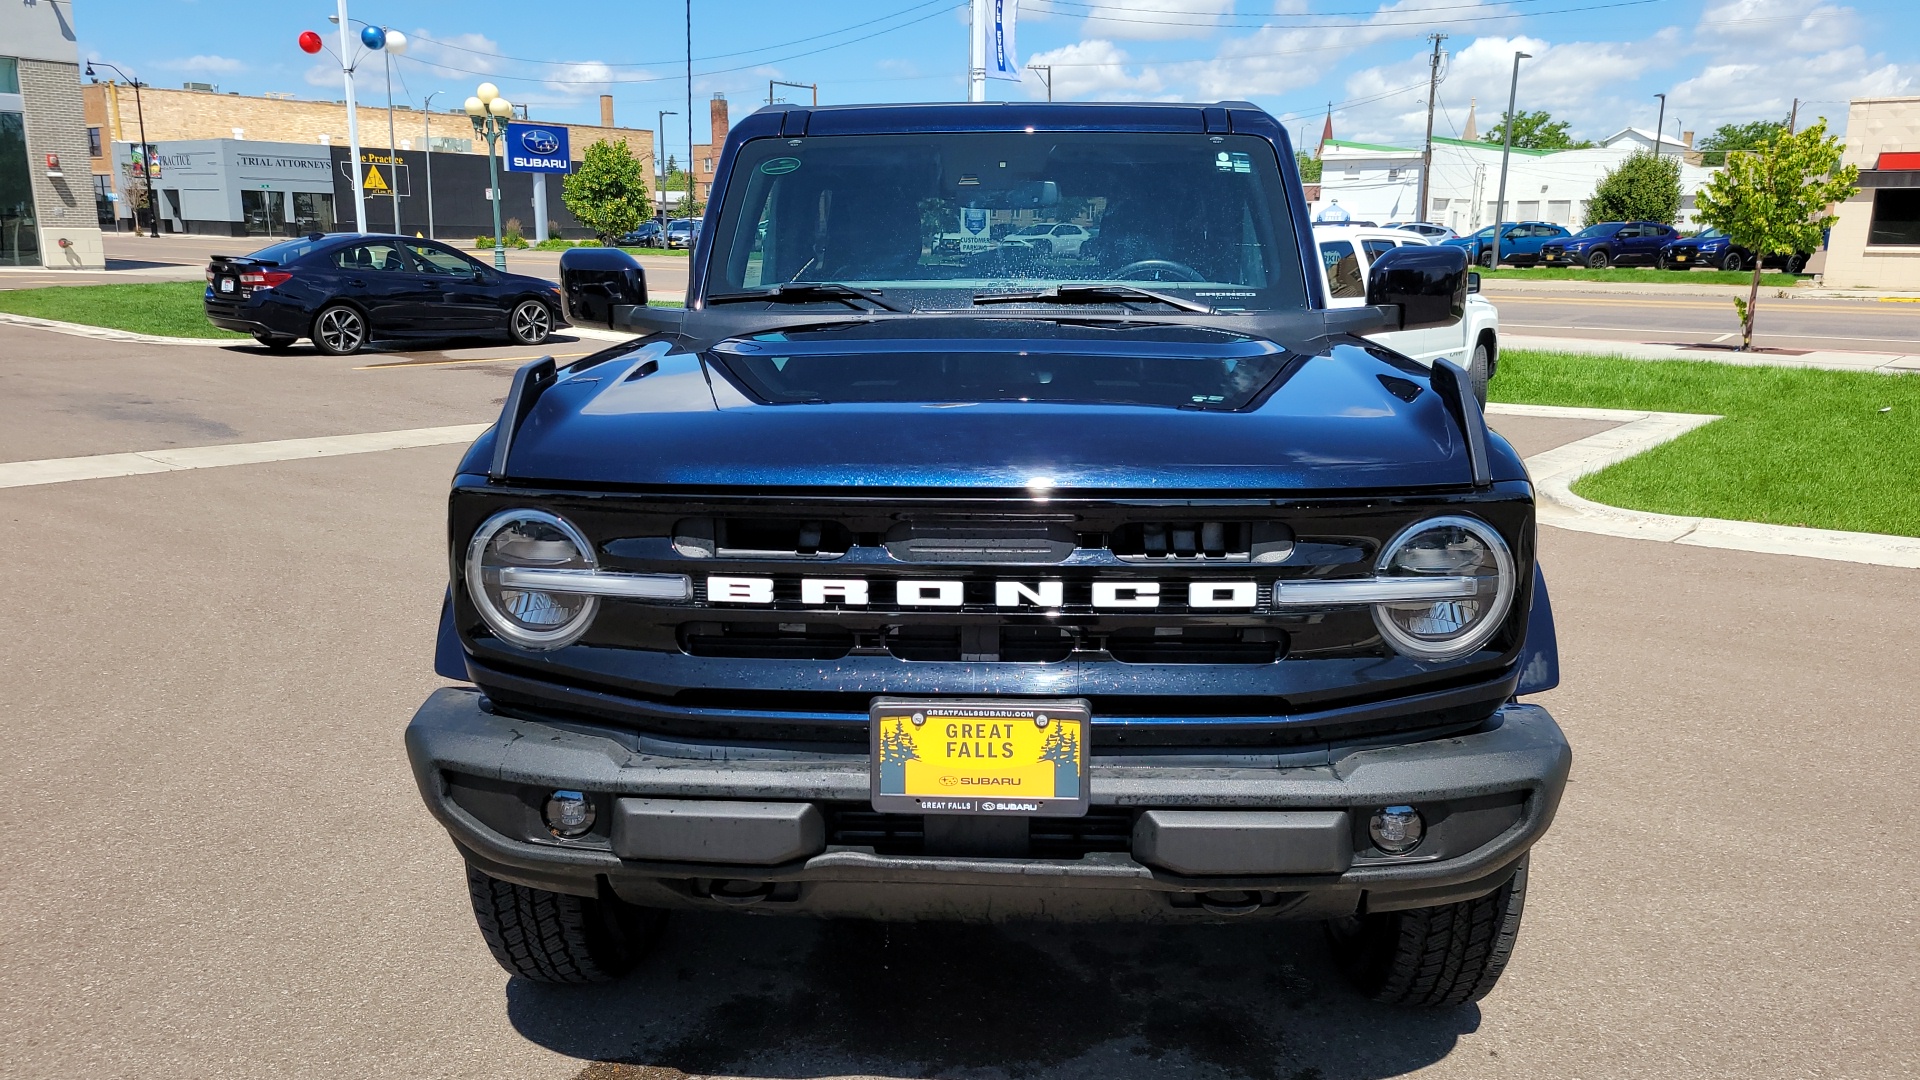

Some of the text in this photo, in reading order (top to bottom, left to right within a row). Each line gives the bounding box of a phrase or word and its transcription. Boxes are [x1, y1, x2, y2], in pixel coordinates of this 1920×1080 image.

[996, 30, 1004, 67] EVENT
[241, 157, 332, 170] TRIAL ATTORNEYS
[368, 153, 404, 164] Practce
[513, 157, 567, 169] SUBARU
[706, 576, 1259, 608] BRONCO
[926, 709, 1035, 718] GREATFALLSSUBARU.COM
[945, 723, 1014, 739] GREAT
[945, 741, 1014, 758] FALLS
[960, 777, 1021, 786] SUBARU
[921, 801, 1038, 811] GREAT FALLS SUBARU
